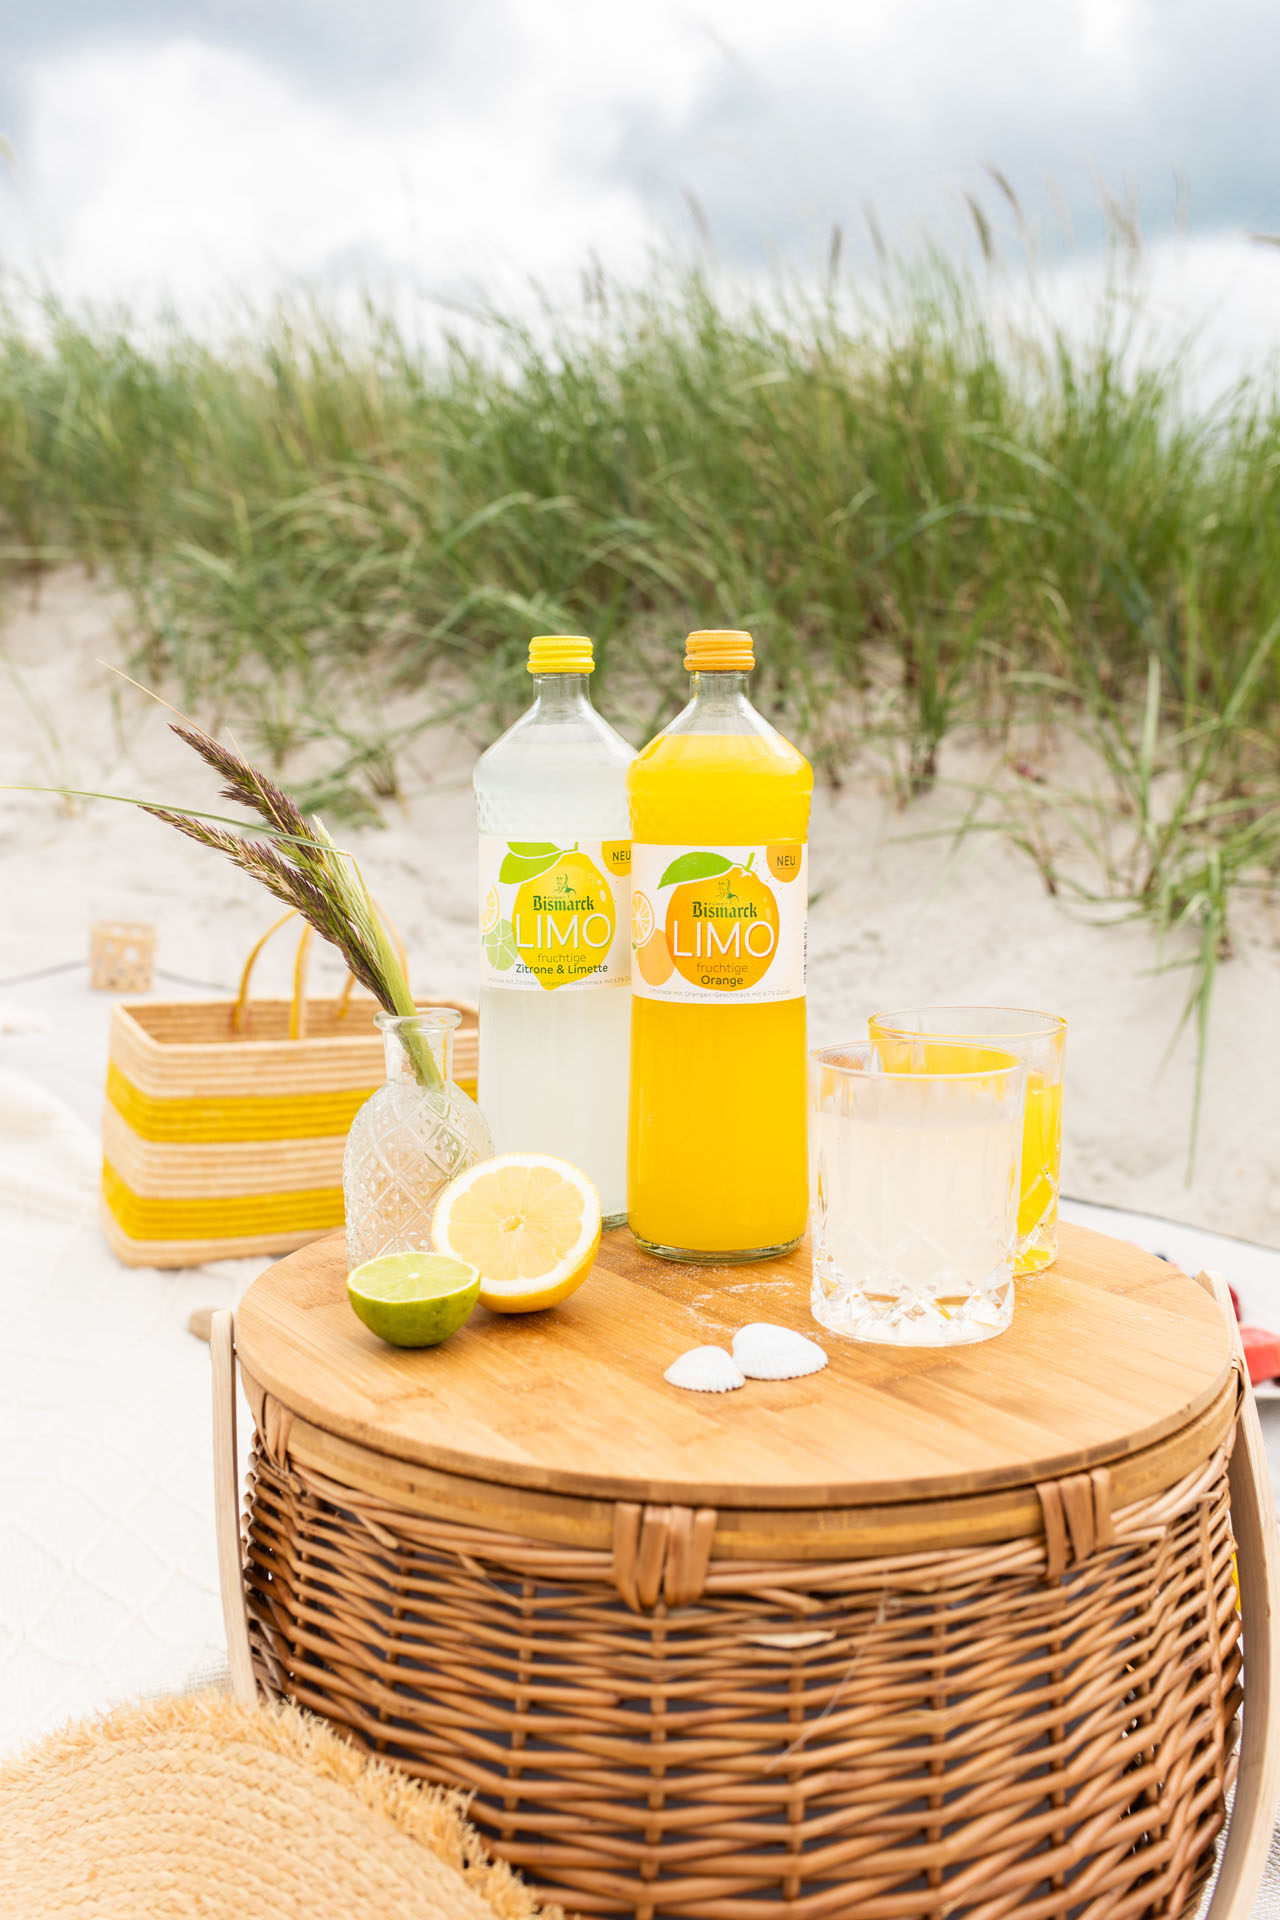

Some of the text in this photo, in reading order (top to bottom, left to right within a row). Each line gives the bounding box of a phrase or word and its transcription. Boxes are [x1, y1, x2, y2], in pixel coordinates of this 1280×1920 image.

[612, 851, 631, 861] NEU
[776, 855, 796, 866] NEU
[532, 895, 595, 911] Bismarck
[692, 901, 758, 918] Bismarck
[516, 912, 613, 949] LIMO
[673, 920, 776, 958] LIMO
[538, 953, 586, 965] fruchtige
[515, 963, 609, 974] Zitrone & Limette
[697, 962, 749, 975] fruchtige
[700, 975, 744, 987] Orange
